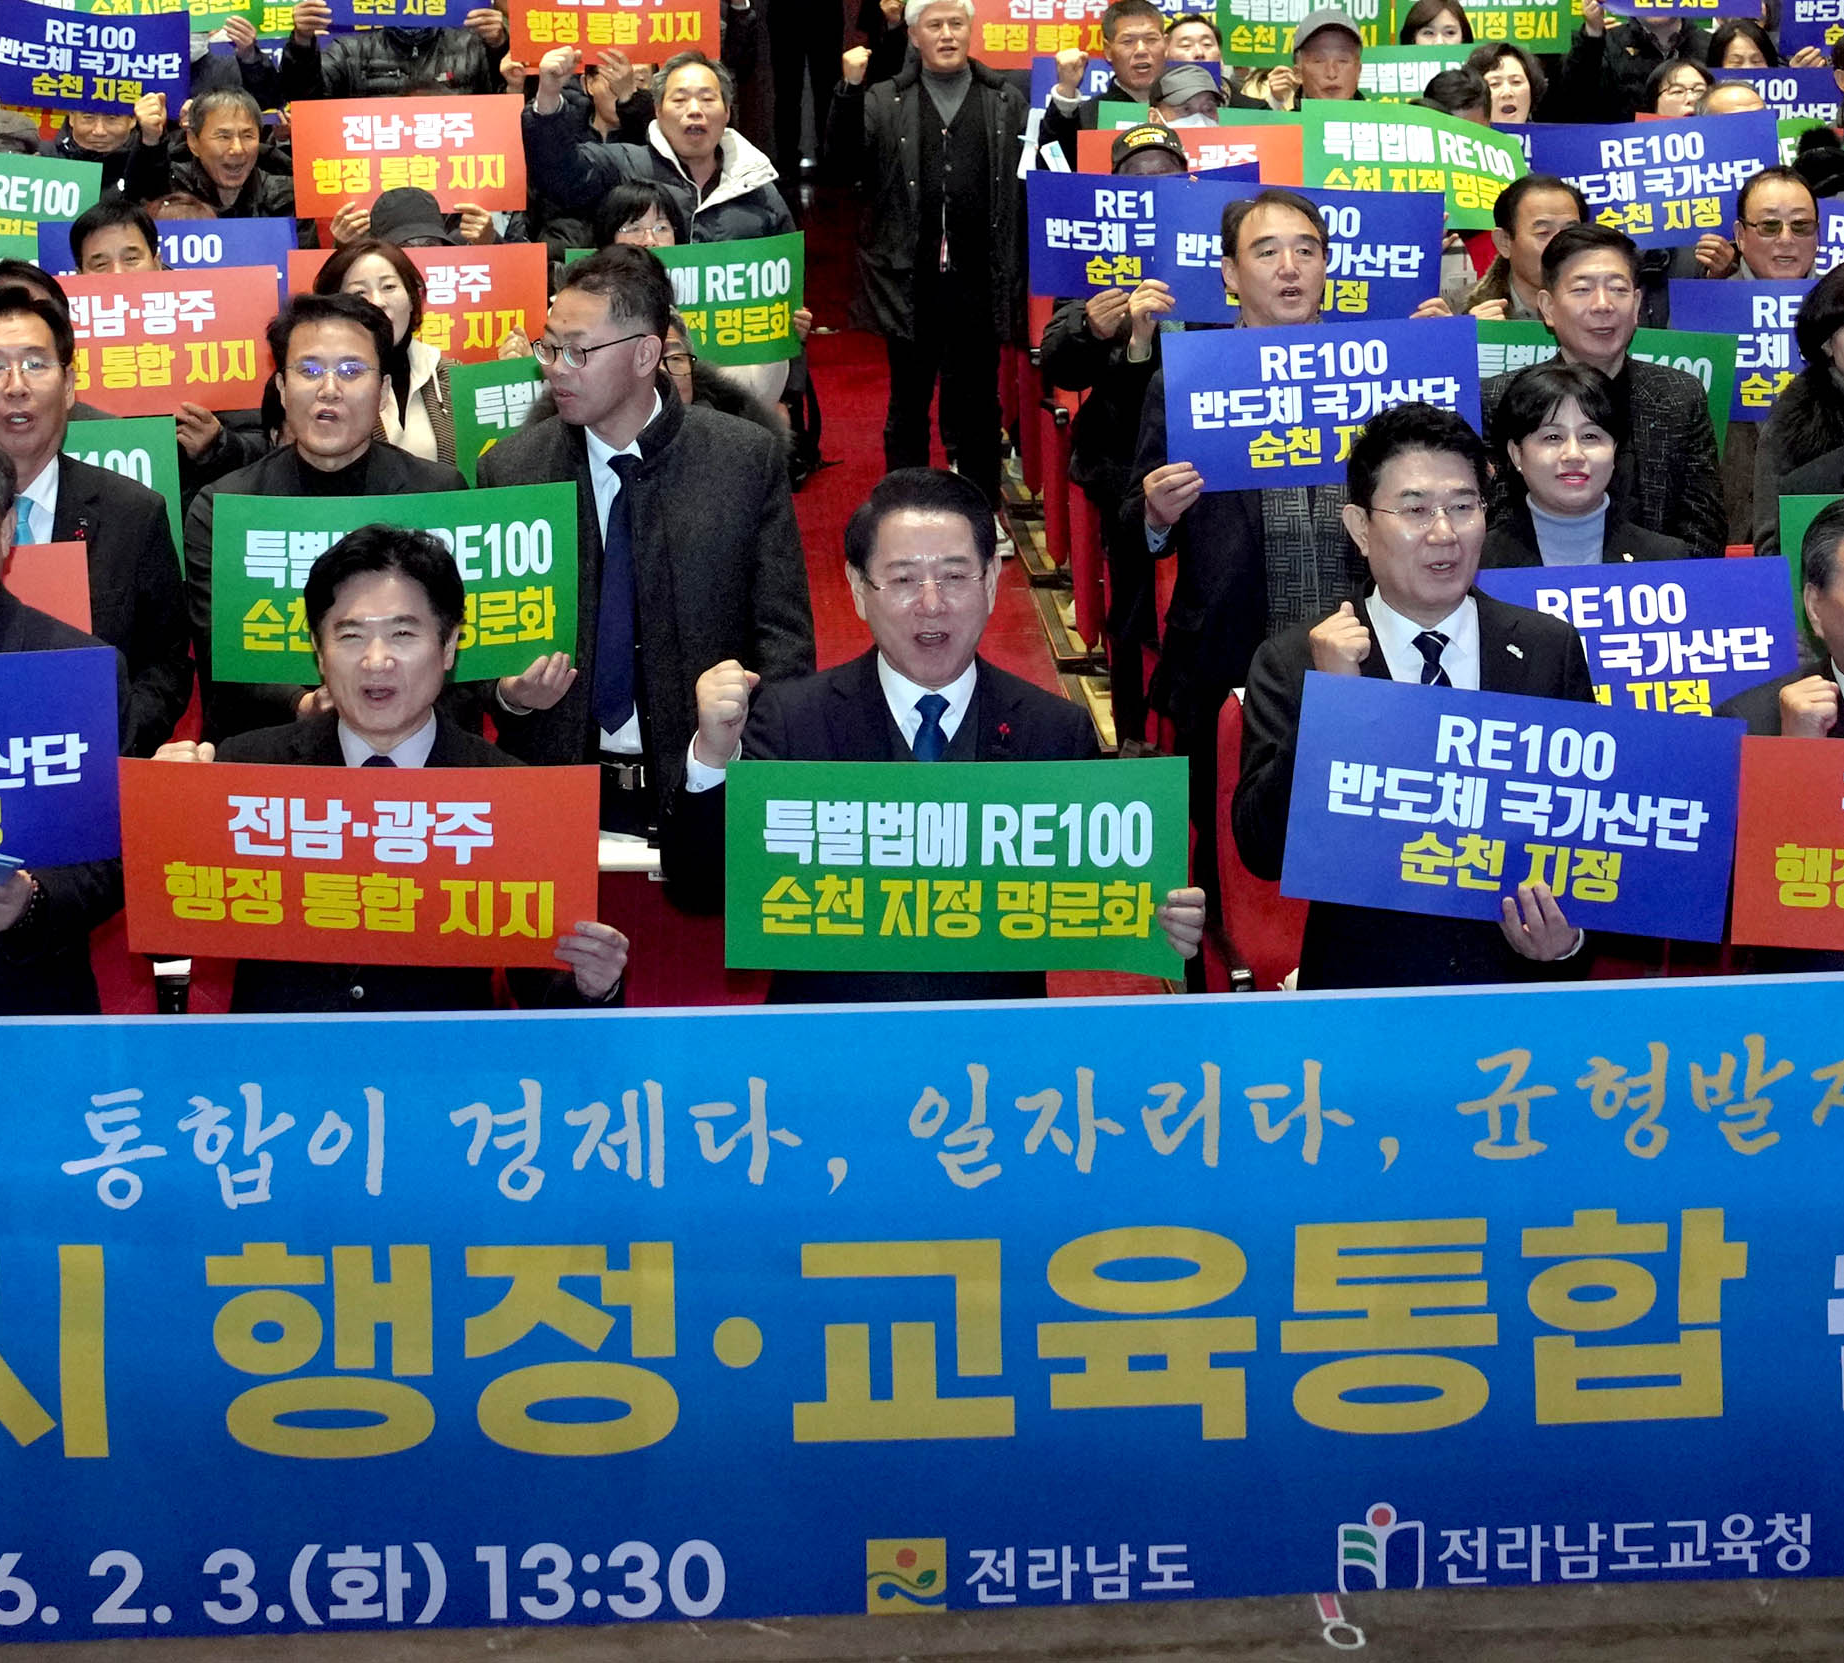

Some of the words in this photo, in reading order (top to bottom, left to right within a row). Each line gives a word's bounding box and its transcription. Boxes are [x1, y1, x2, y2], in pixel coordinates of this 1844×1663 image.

[1436, 715, 1616, 780] RE100
[228, 796, 493, 864] 전남·광주
[763, 800, 967, 867] 특별법에
[981, 801, 1152, 867] RE100
[1328, 760, 1485, 829] 반도체
[1500, 786, 1709, 852] 국가산단
[164, 862, 283, 924] 행정
[302, 872, 423, 932] 통합
[440, 880, 554, 938] 지지
[1401, 833, 1504, 890] 순천
[1520, 845, 1621, 901] 지정
[762, 875, 863, 935] 순천
[880, 879, 981, 937] 지정
[998, 881, 1154, 938] 명문화
[61, 1083, 384, 1209] 통합이
[450, 1078, 849, 1195] 경제다,
[907, 1058, 1399, 1188] 일자리다,
[205, 1206, 1747, 1458] 행정·교육통합
[966, 1544, 1194, 1601] 전라남도
[1439, 1513, 1811, 1576] 전라남도교육청
[89, 1550, 172, 1623] 2.
[203, 1543, 447, 1625] 3.(화)
[476, 1540, 725, 1620] 13:30
